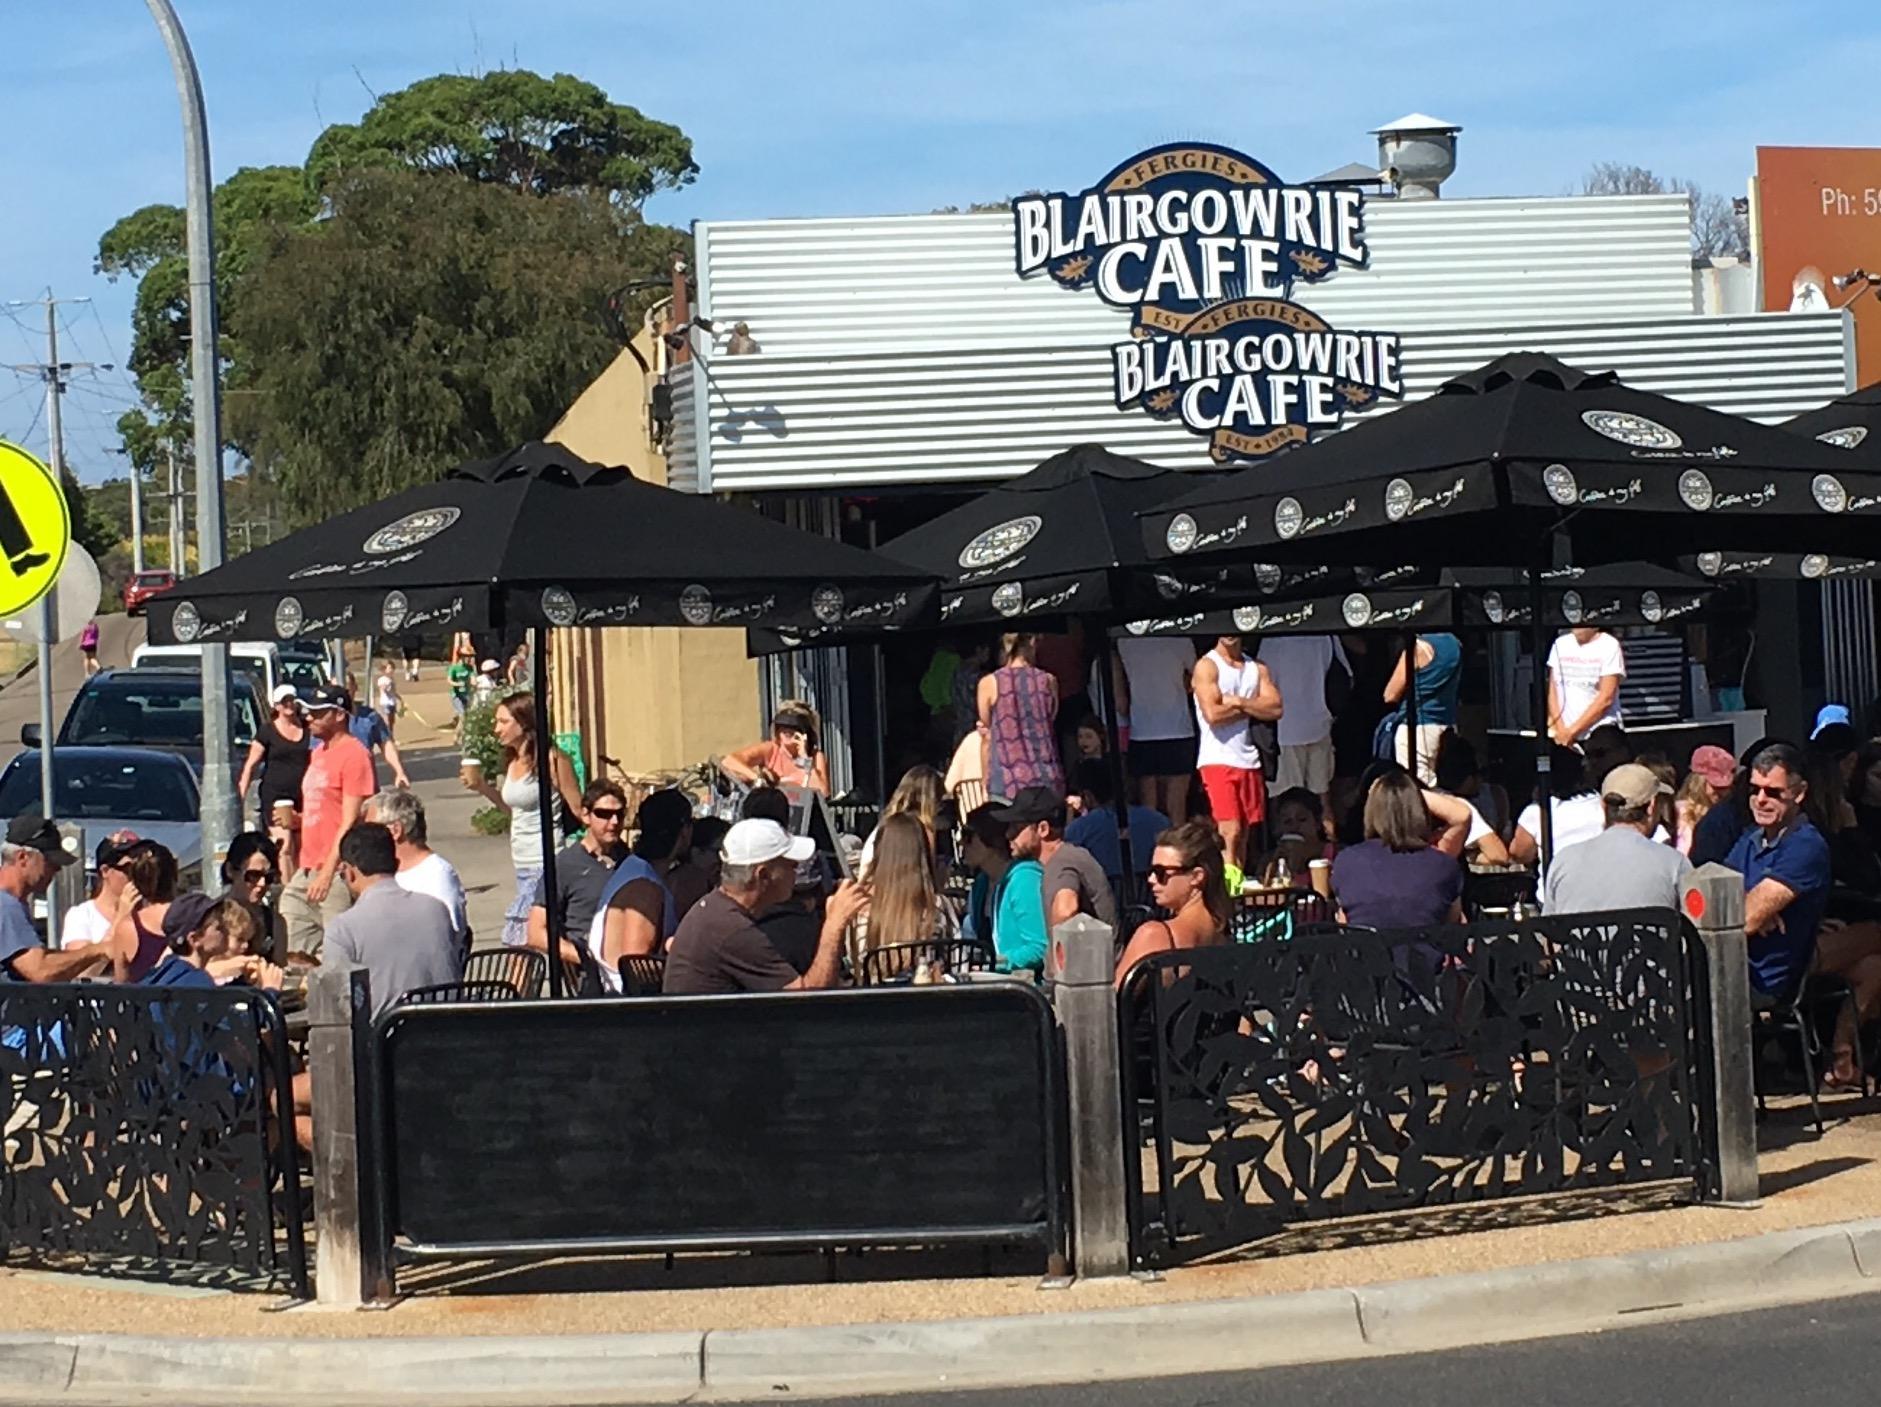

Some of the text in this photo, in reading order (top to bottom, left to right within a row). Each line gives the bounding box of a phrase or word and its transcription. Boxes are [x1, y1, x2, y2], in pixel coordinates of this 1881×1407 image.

[1133, 152, 1237, 181] FERGIES
[1821, 187, 1881, 216] Ph: 5
[1016, 188, 1366, 272] BLAIRGOWRIE
[1097, 237, 1284, 304] CAFE
[1153, 311, 1182, 330] EST
[1210, 302, 1301, 327] FERGIES
[1115, 332, 1402, 403] BLAIRGOWRIE
[1181, 375, 1340, 430] CAFE
